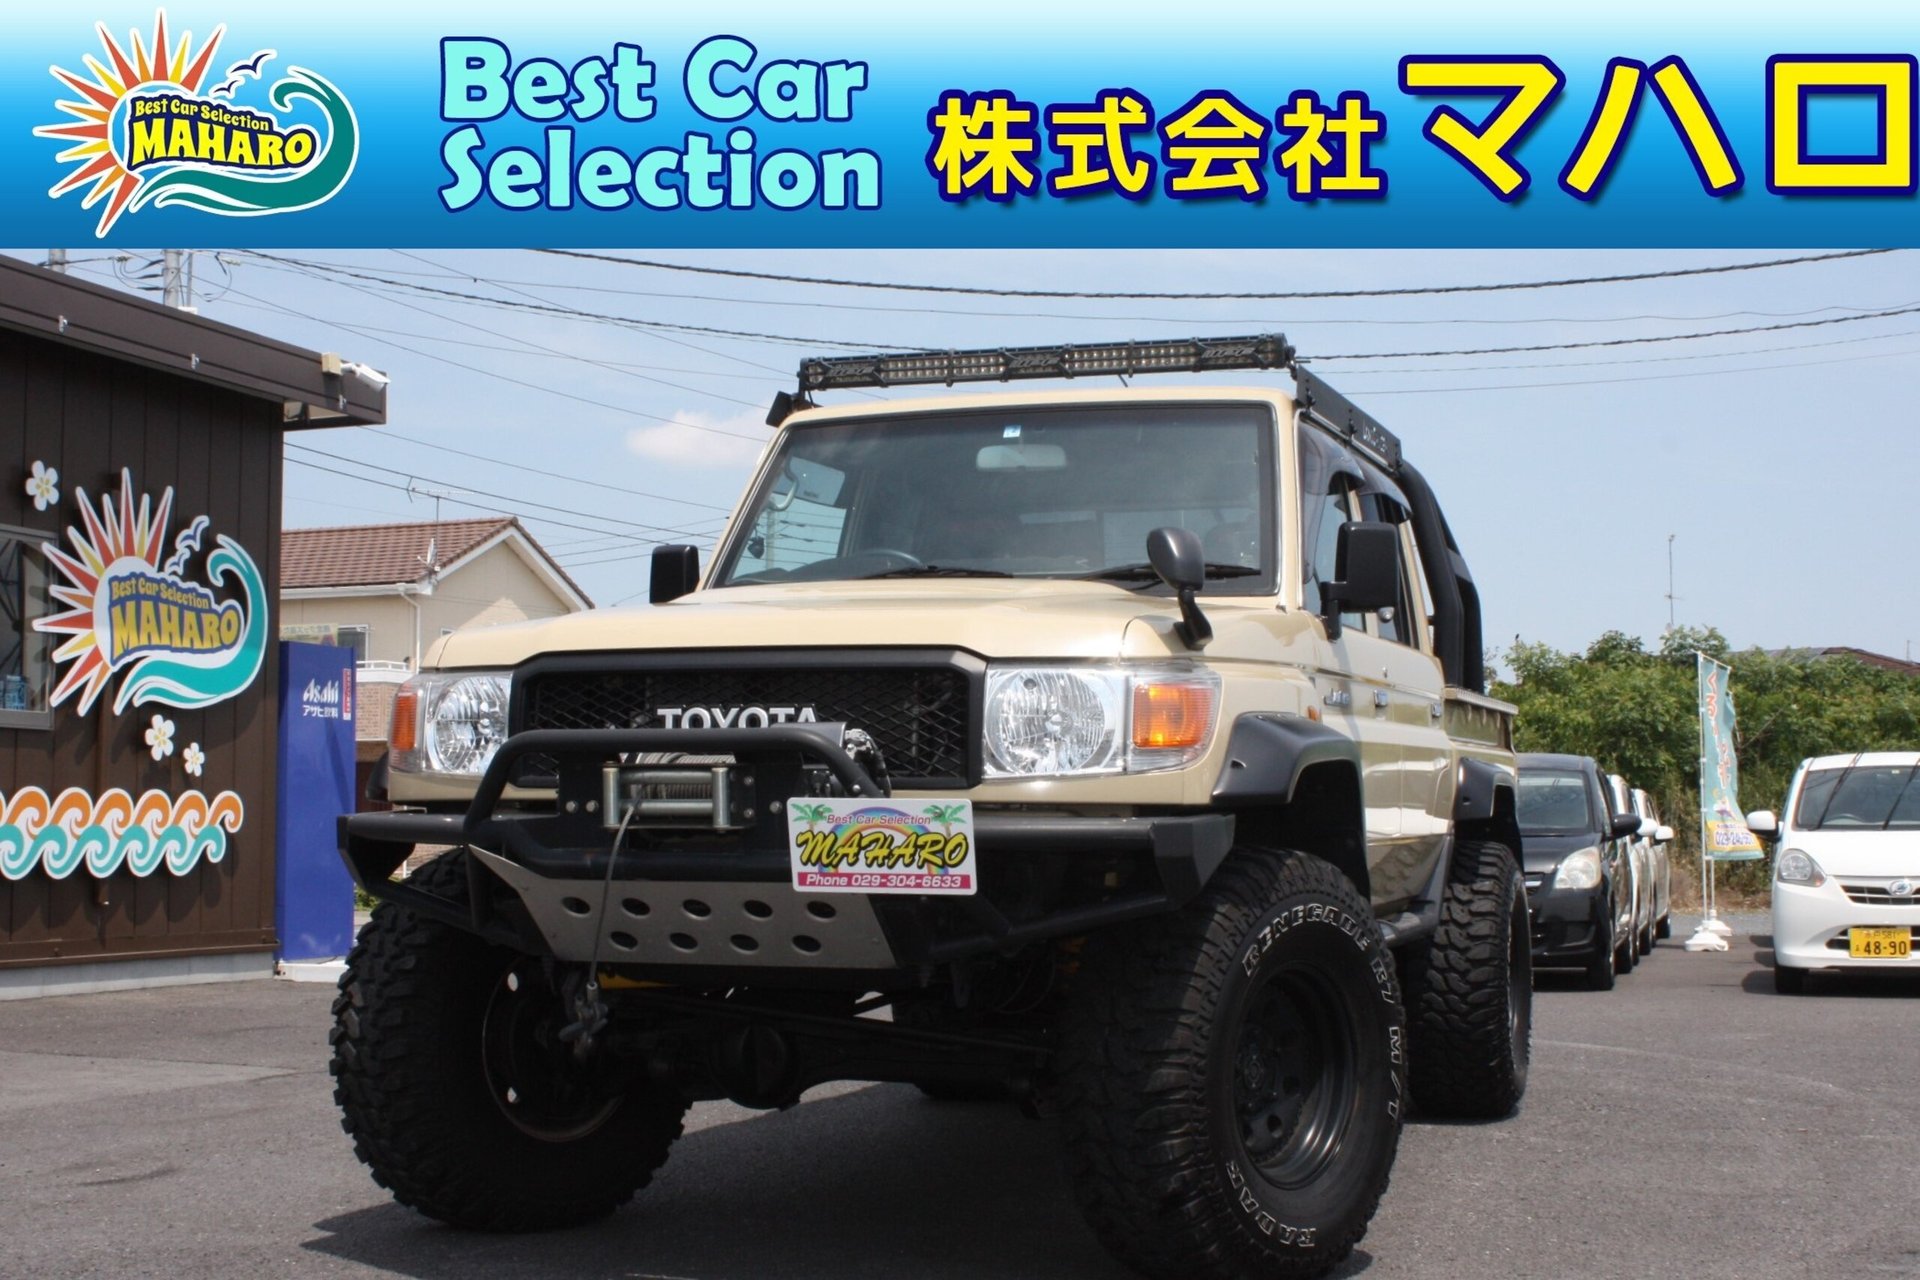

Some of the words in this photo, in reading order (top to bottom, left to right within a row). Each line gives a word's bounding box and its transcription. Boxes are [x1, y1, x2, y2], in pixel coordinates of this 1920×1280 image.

[111, 577, 137, 600] Best
[138, 578, 160, 597] Car
[160, 582, 210, 609] Selection
[111, 600, 239, 660] MAHARO
[303, 678, 339, 705] Asahi
[303, 704, 339, 719] アサヒ飲料
[656, 706, 817, 729] TOYOTA
[827, 814, 853, 825] Best
[856, 814, 877, 825] Car
[879, 814, 931, 826] Selection
[796, 829, 970, 870] MAHARO
[806, 873, 848, 886] Phone
[851, 874, 962, 888] 029-304-6633
[1242, 903, 1371, 977] RENEGADE
[1863, 940, 1908, 956] 48-90
[1225, 1160, 1317, 1249] RADAR
